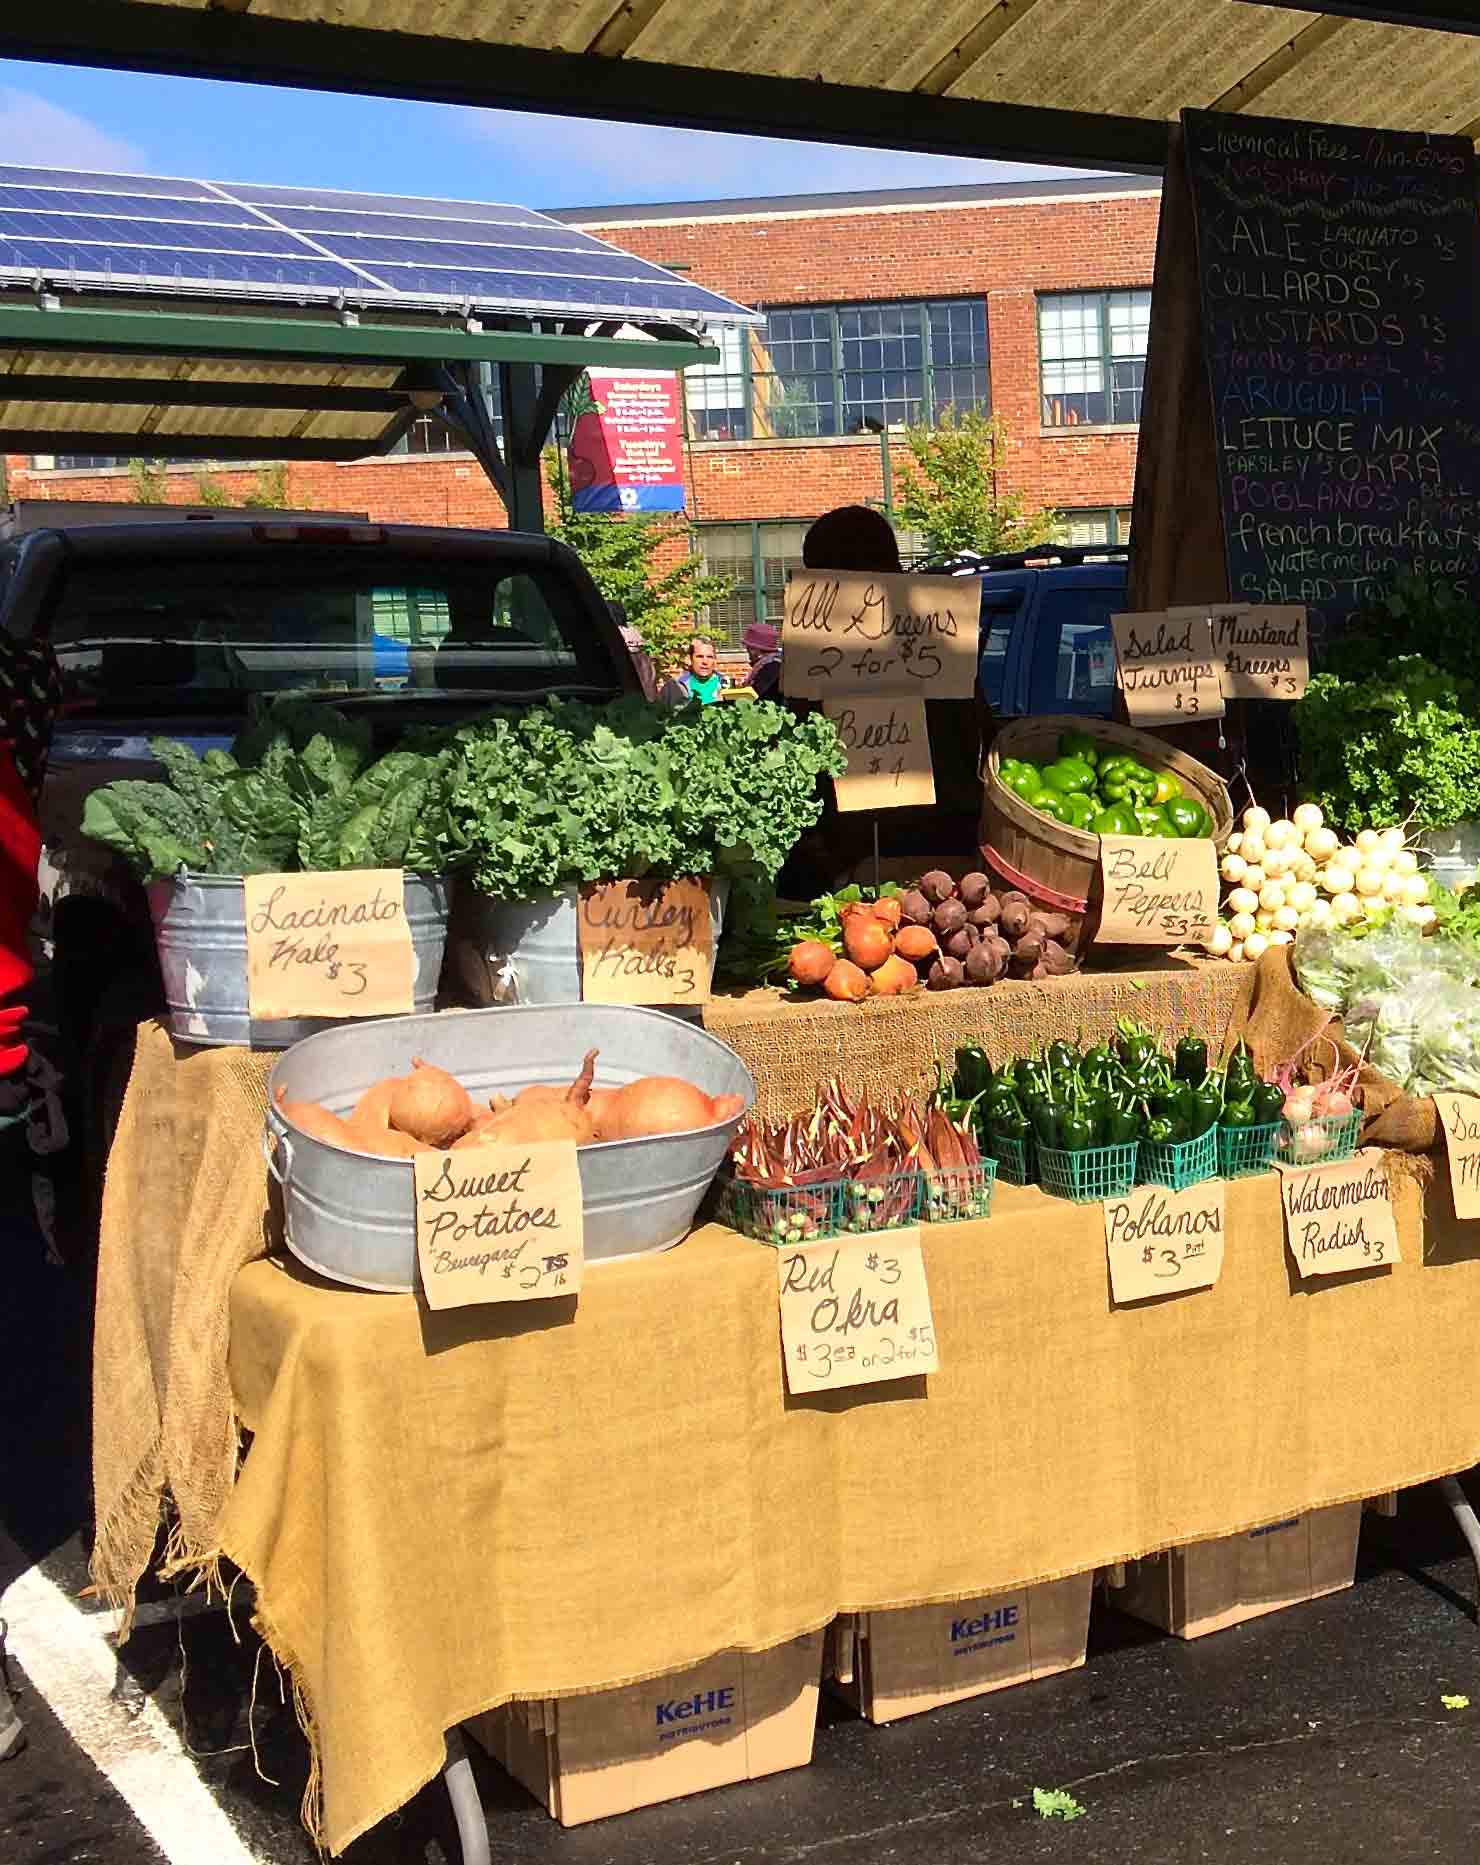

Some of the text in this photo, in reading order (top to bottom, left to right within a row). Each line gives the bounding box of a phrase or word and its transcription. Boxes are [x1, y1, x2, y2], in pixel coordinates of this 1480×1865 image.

[1323, 224, 1419, 248] LACINATO
[1205, 262, 1383, 310] COLLARDS
[1221, 376, 1386, 416] ARUGULA
[1220, 416, 1356, 452] LETTUCE
[1371, 423, 1445, 456] MIX
[1226, 454, 1311, 481] PARSLEY
[1339, 451, 1442, 485] OKRA
[1335, 511, 1470, 551] breakfast
[1238, 570, 1338, 604] SALAD
[790, 580, 959, 641] All Greens
[1121, 622, 1195, 660] Salad
[1217, 615, 1302, 648] Mustard
[807, 636, 943, 680] 2 for $5
[1123, 657, 1216, 693] Turnips
[1224, 650, 1291, 675] Greens
[1175, 692, 1200, 717] $3
[1270, 674, 1298, 695] $3
[828, 709, 913, 750] Beets
[1108, 848, 1179, 881] Bell
[250, 885, 401, 934] Lacinato
[1112, 883, 1206, 928] Peppers
[268, 931, 340, 972] Kale
[591, 935, 667, 978] Kale
[324, 961, 368, 996] $3
[421, 1157, 531, 1203] Sweet
[1287, 1166, 1390, 1218] Watermelon
[424, 1197, 562, 1247] Potatoes
[1108, 1192, 1222, 1243] Poblanos
[1299, 1216, 1368, 1260] Radish
[1362, 1240, 1386, 1264] $3
[499, 1262, 542, 1290] $2
[781, 1248, 902, 1296] Red $3
[1141, 1243, 1182, 1278] $3
[810, 1286, 900, 1337] Okra
[794, 1342, 833, 1379] $3
[878, 1336, 896, 1365] 2
[949, 1605, 1019, 1643] KeHE
[656, 1686, 736, 1727] KeHE
